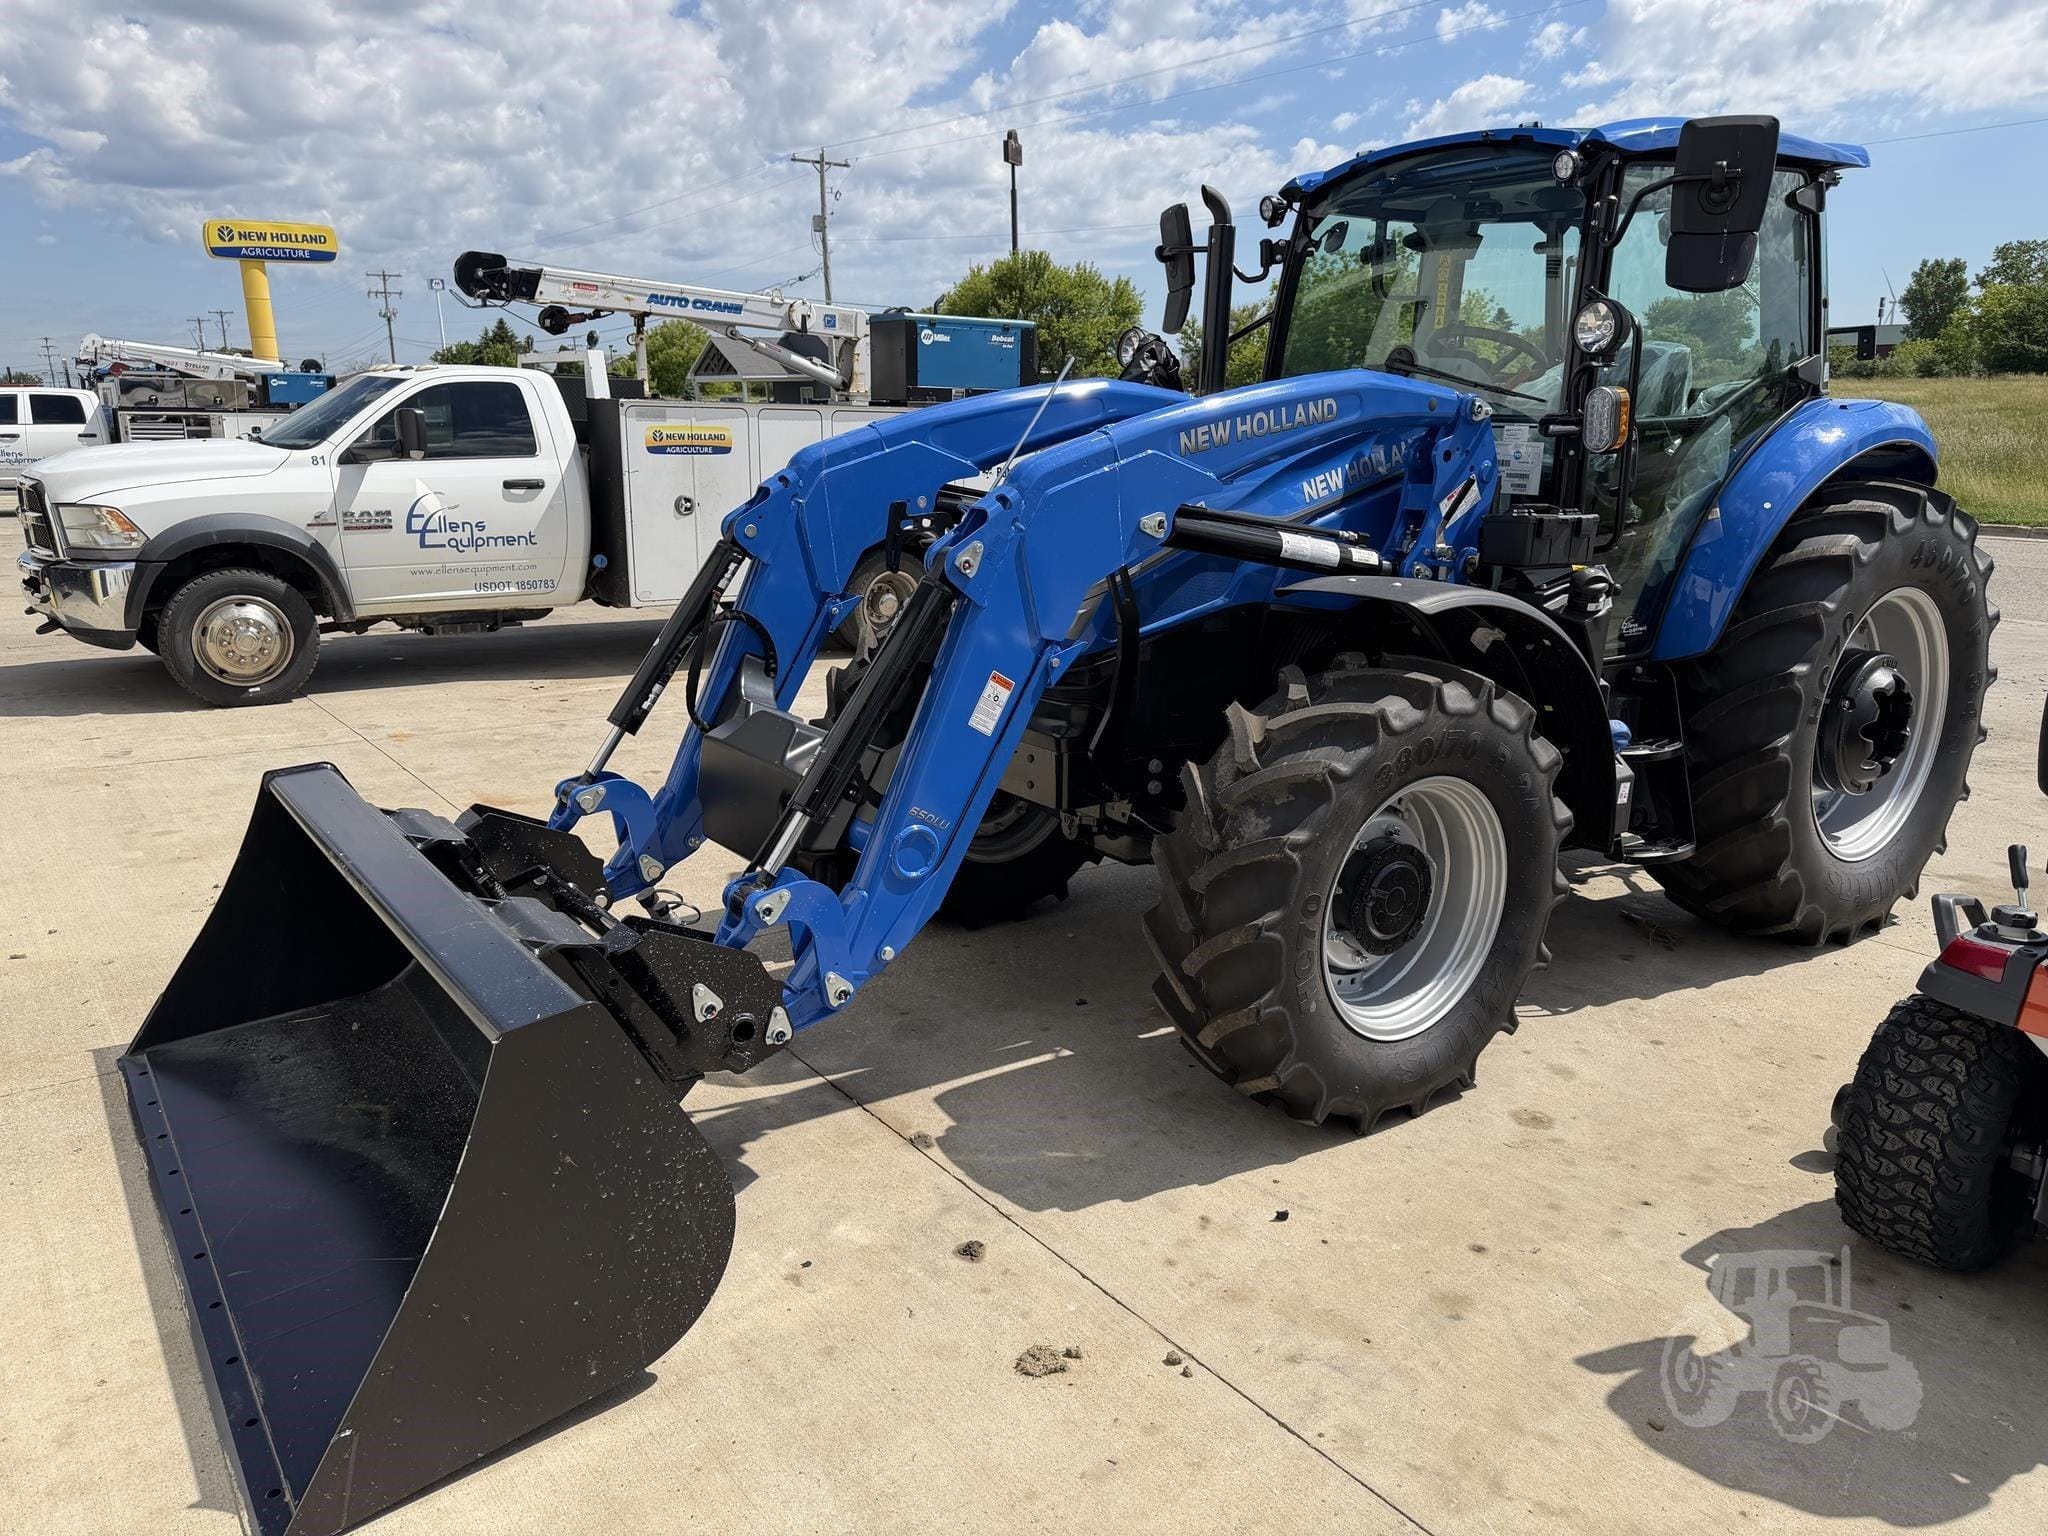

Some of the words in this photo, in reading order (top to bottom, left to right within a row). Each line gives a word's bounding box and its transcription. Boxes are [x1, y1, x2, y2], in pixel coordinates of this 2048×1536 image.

[237, 230, 268, 242] NEW
[271, 232, 327, 245] HOLLAND
[240, 246, 310, 259] AGRICULTURE
[646, 292, 690, 309] AUTO
[691, 297, 744, 316] CRANE
[1179, 420, 1232, 456] NEW
[1235, 397, 1338, 442] HOLLAND
[666, 432, 686, 441] NEW
[687, 433, 726, 442] HOLLAND
[0, 448, 24, 458] llens
[665, 446, 713, 454] AGRICULTURE
[311, 455, 326, 466] 81
[1302, 466, 1344, 504] NEW
[406, 491, 487, 534] Ellens
[419, 506, 538, 553] Equipment
[410, 563, 538, 577] www.ellensequipment.com
[474, 580, 513, 593] USDOT
[515, 578, 556, 591] 1850783
